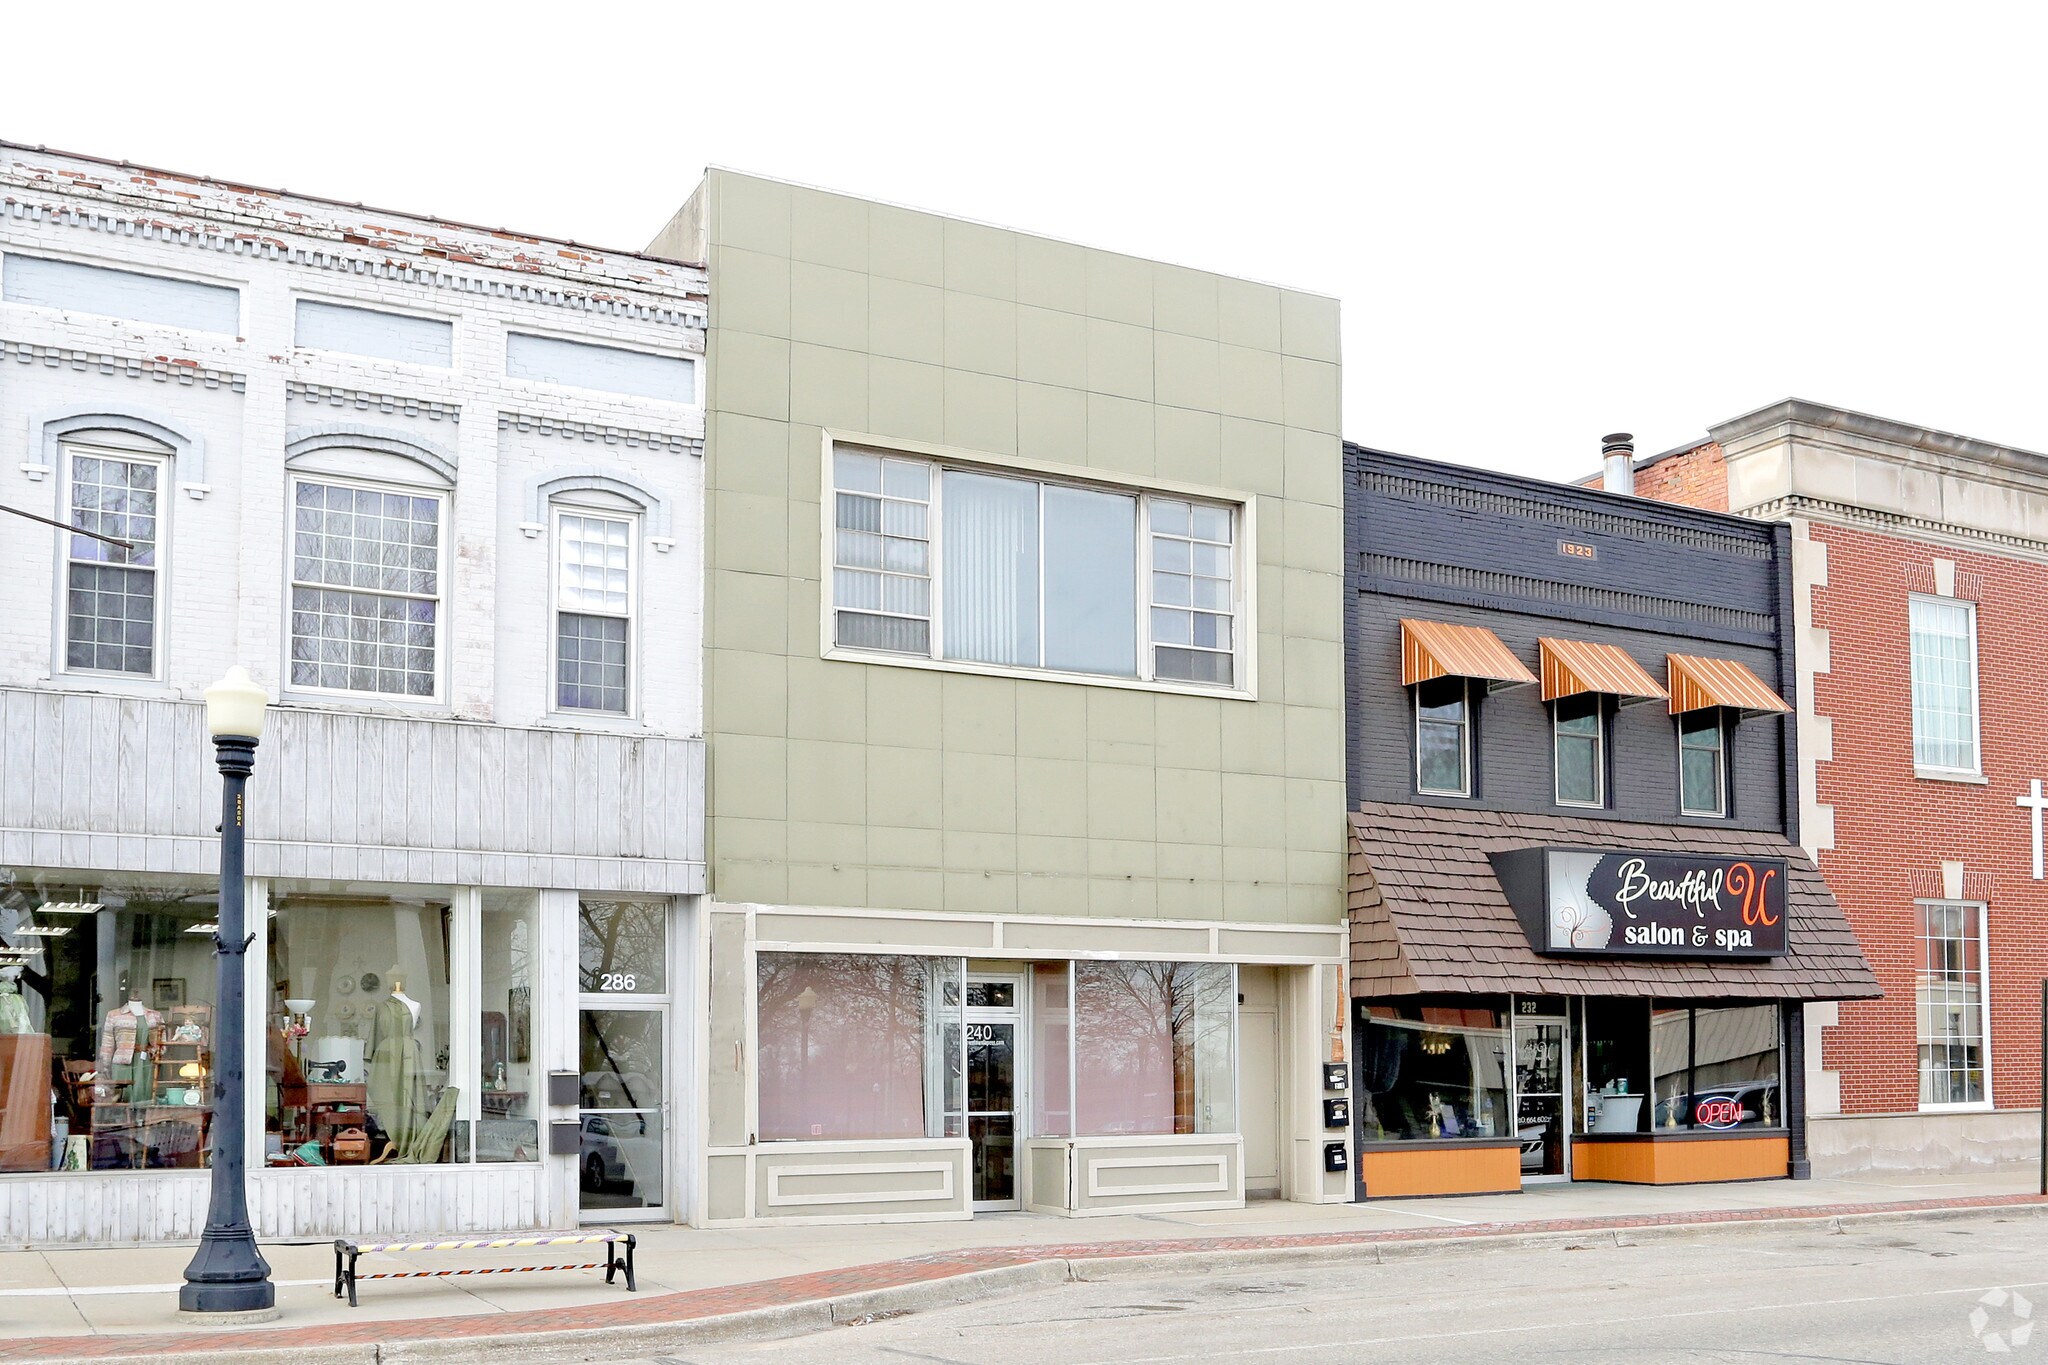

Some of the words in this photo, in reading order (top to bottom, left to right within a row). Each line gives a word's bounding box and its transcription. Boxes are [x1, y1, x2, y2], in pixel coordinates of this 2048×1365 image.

[1562, 543, 1592, 557] 1923
[1616, 858, 1723, 919] Beautiful
[1725, 862, 1779, 926] U
[1624, 922, 1684, 946] salon
[1691, 925, 1708, 947] &
[1715, 927, 1753, 951] spa
[600, 973, 636, 991] 286
[1521, 1001, 1537, 1013] 232
[966, 1025, 992, 1040] 240
[1697, 1103, 1742, 1124] OPEN
